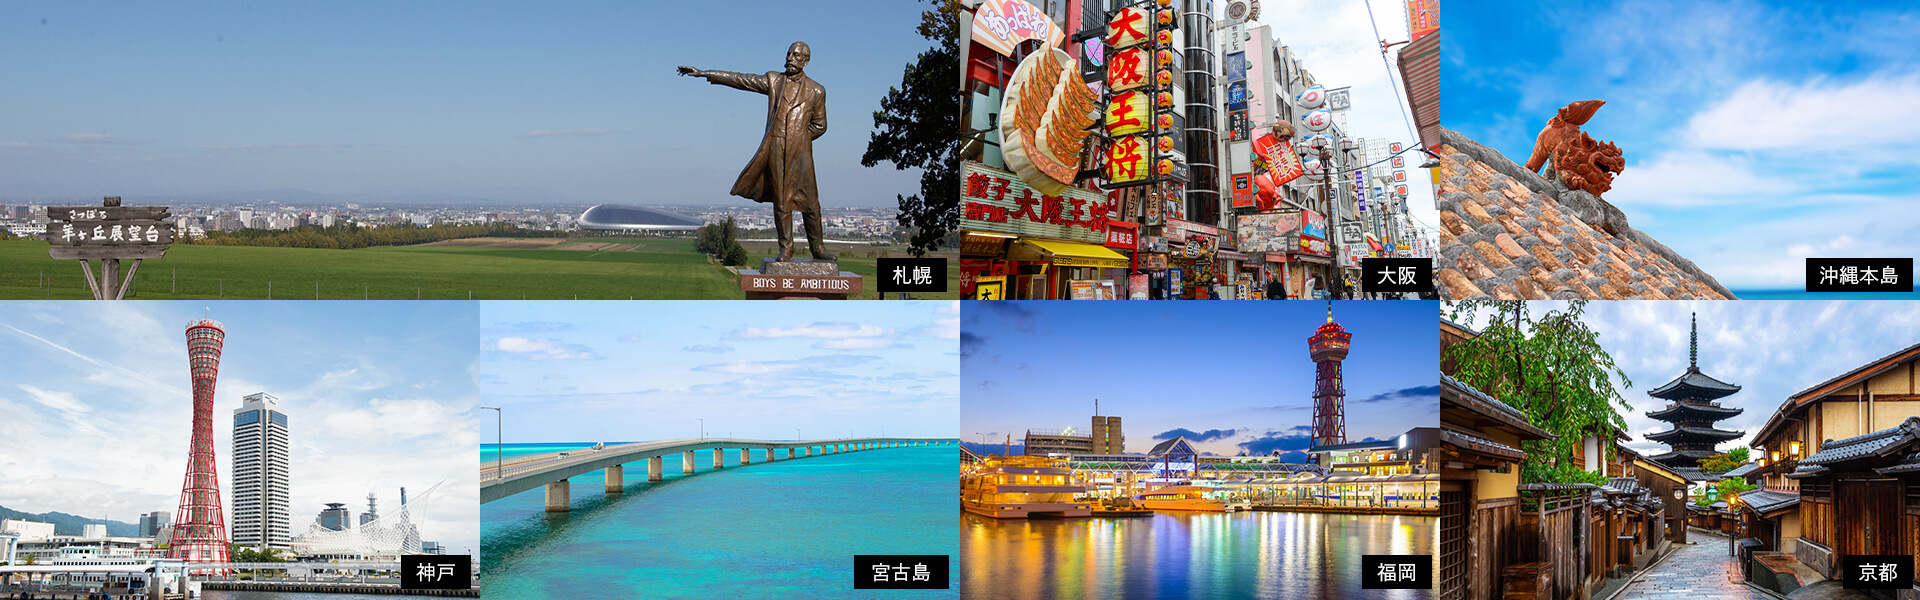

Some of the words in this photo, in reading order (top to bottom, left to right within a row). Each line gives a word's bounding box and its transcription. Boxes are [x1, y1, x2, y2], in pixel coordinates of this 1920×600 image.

[1102, 7, 1147, 181] 大阪王将
[966, 172, 1011, 200] 餃子
[69, 209, 107, 220] さっぽろ
[1009, 188, 1109, 233] 大阪王将
[753, 278, 776, 288] BOYS
[782, 279, 794, 289] BE
[801, 279, 850, 290] AMBITIOUS
